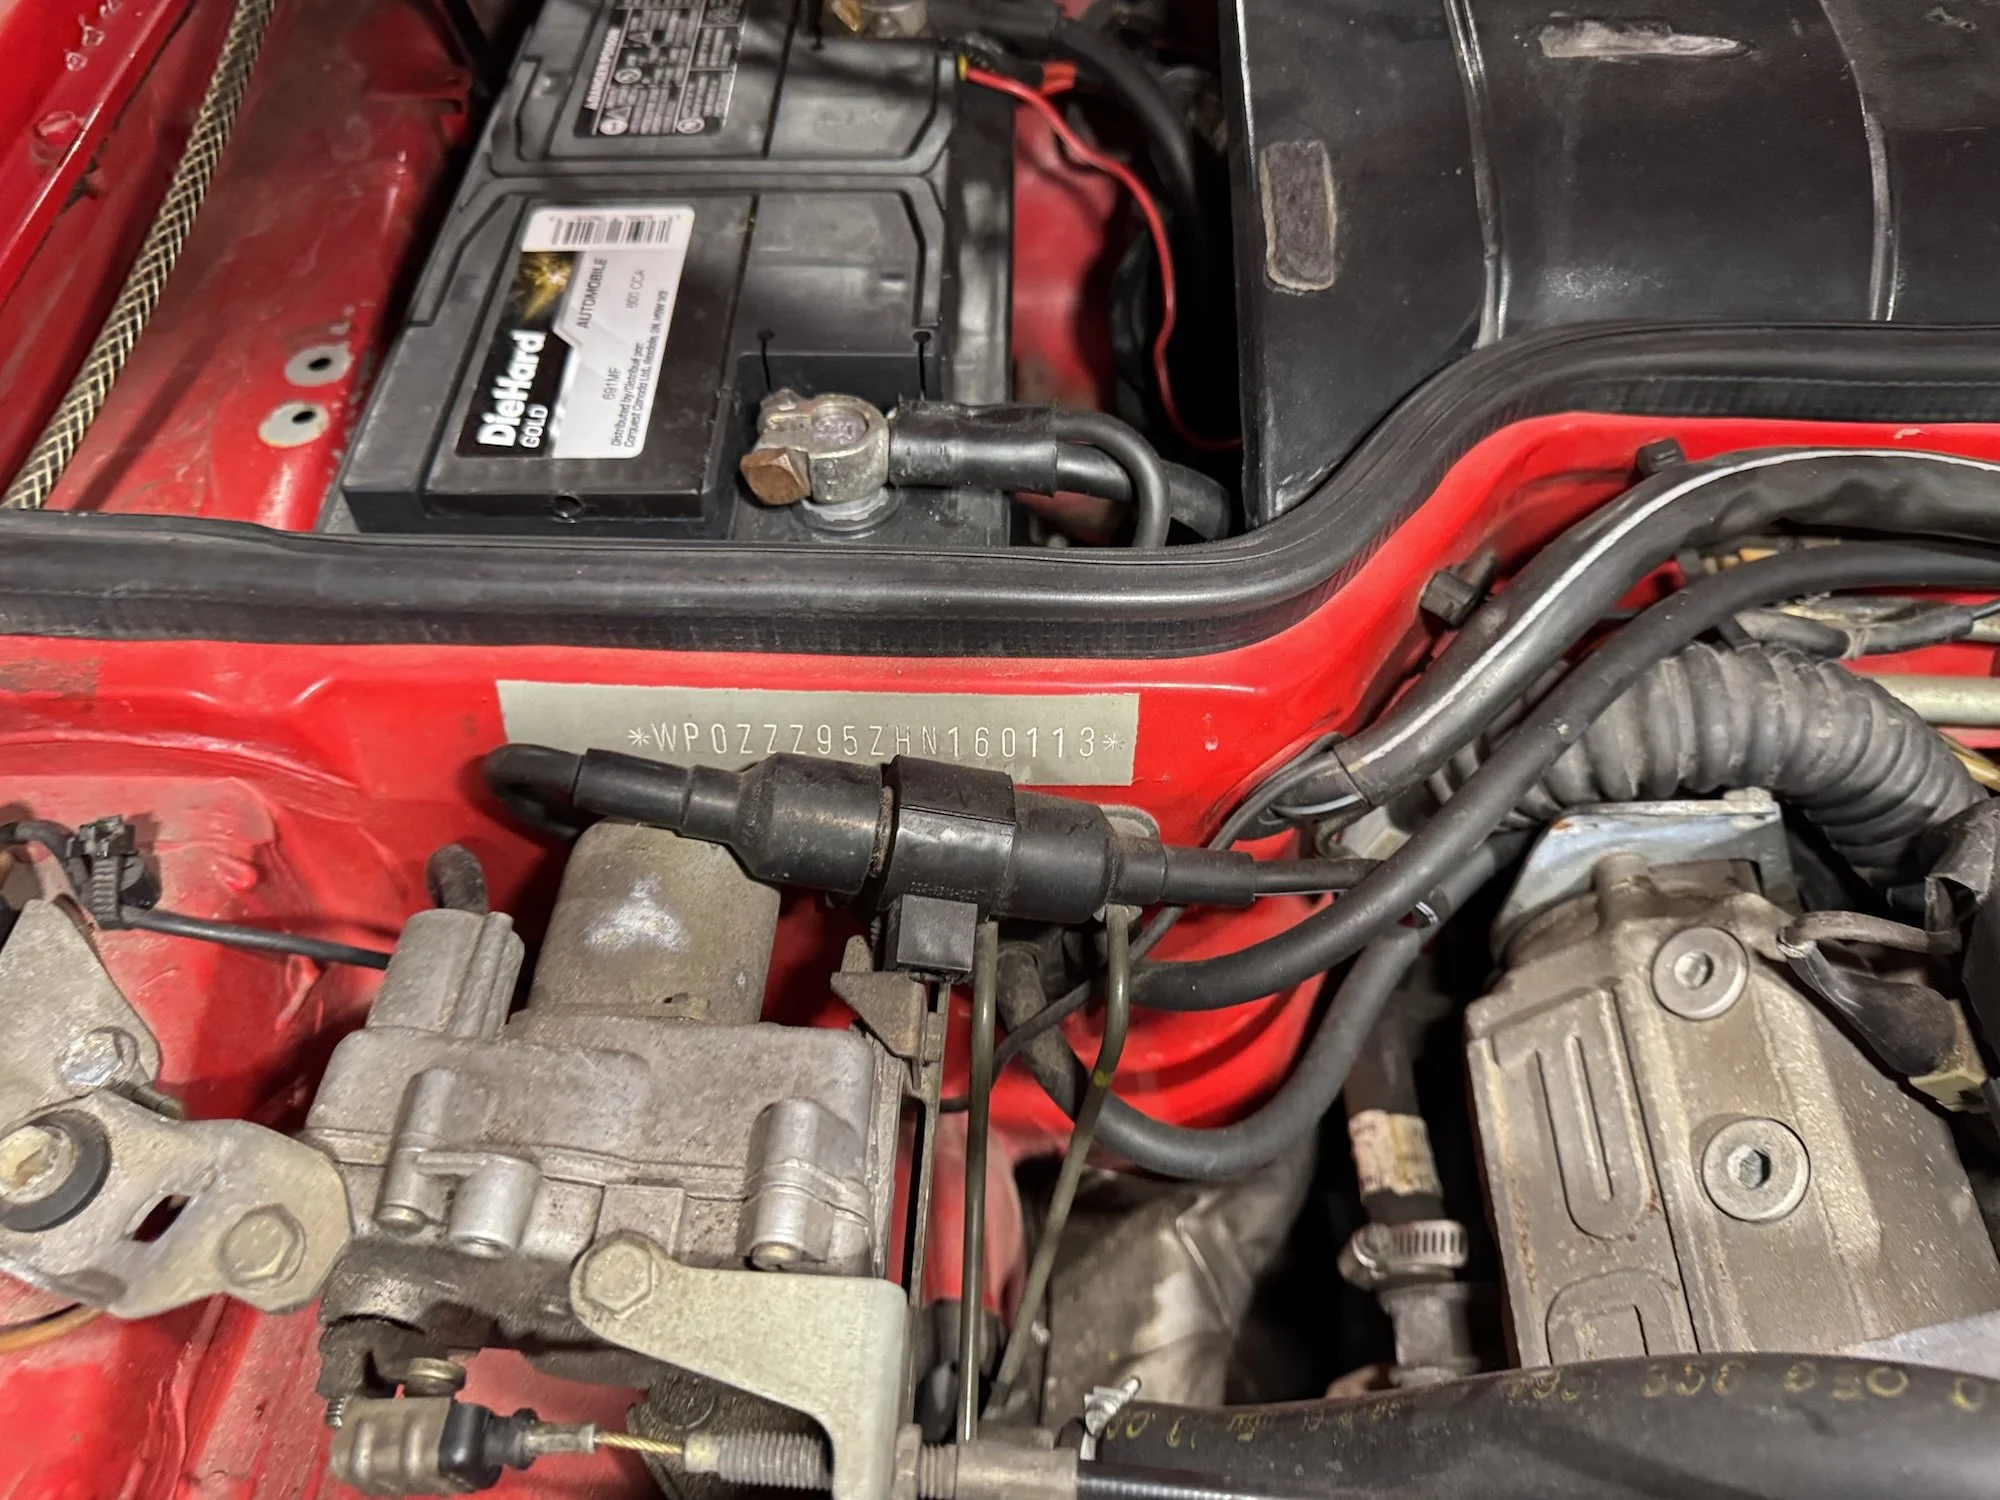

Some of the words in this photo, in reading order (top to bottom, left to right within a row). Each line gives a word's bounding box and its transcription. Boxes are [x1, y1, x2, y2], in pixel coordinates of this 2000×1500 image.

[576, 258, 608, 330] AUTOMOBILE
[477, 330, 547, 447] DieHard
[602, 366, 622, 401] 691MF
[519, 403, 548, 448] GOLD
[611, 402, 631, 447] Distributed
[623, 412, 641, 448] Carquest
[633, 382, 648, 411] Canada
